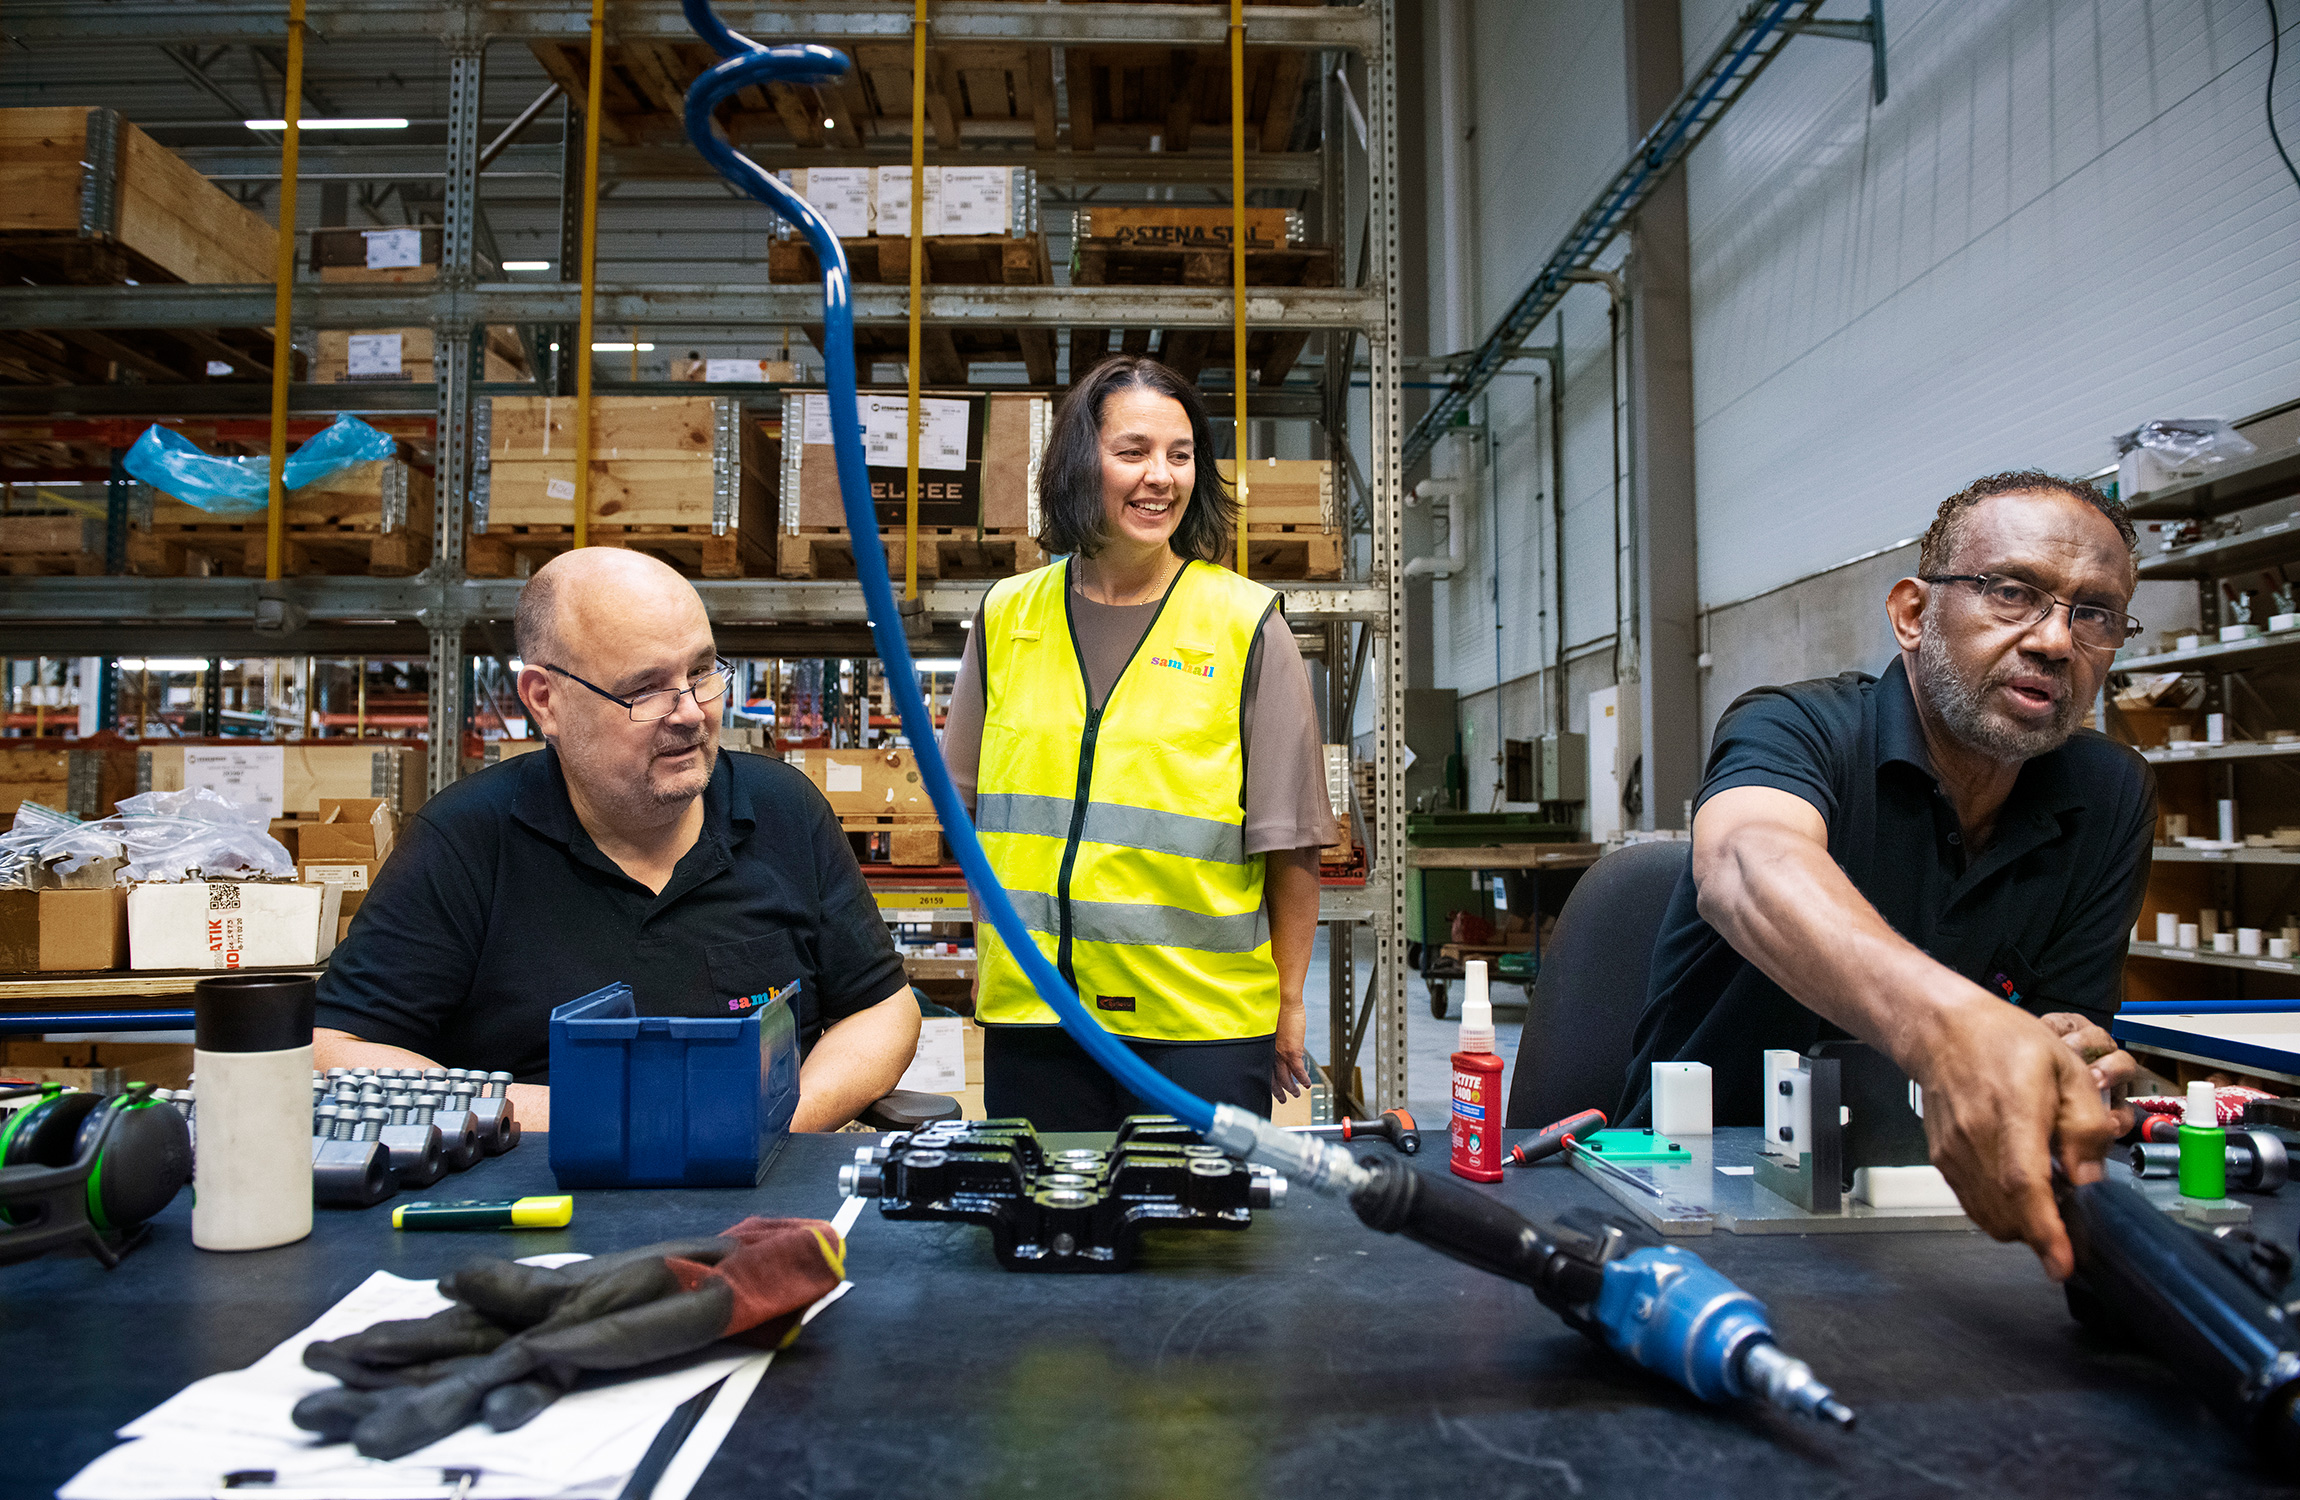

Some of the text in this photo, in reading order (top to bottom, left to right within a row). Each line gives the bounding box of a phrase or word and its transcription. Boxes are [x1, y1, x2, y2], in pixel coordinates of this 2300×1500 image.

[1136, 225, 1204, 242] STENA
[1151, 657, 1215, 678] samhall
[920, 897, 944, 905] 26159
[728, 981, 794, 1010] samh
[1454, 1084, 1472, 1102] 2400
